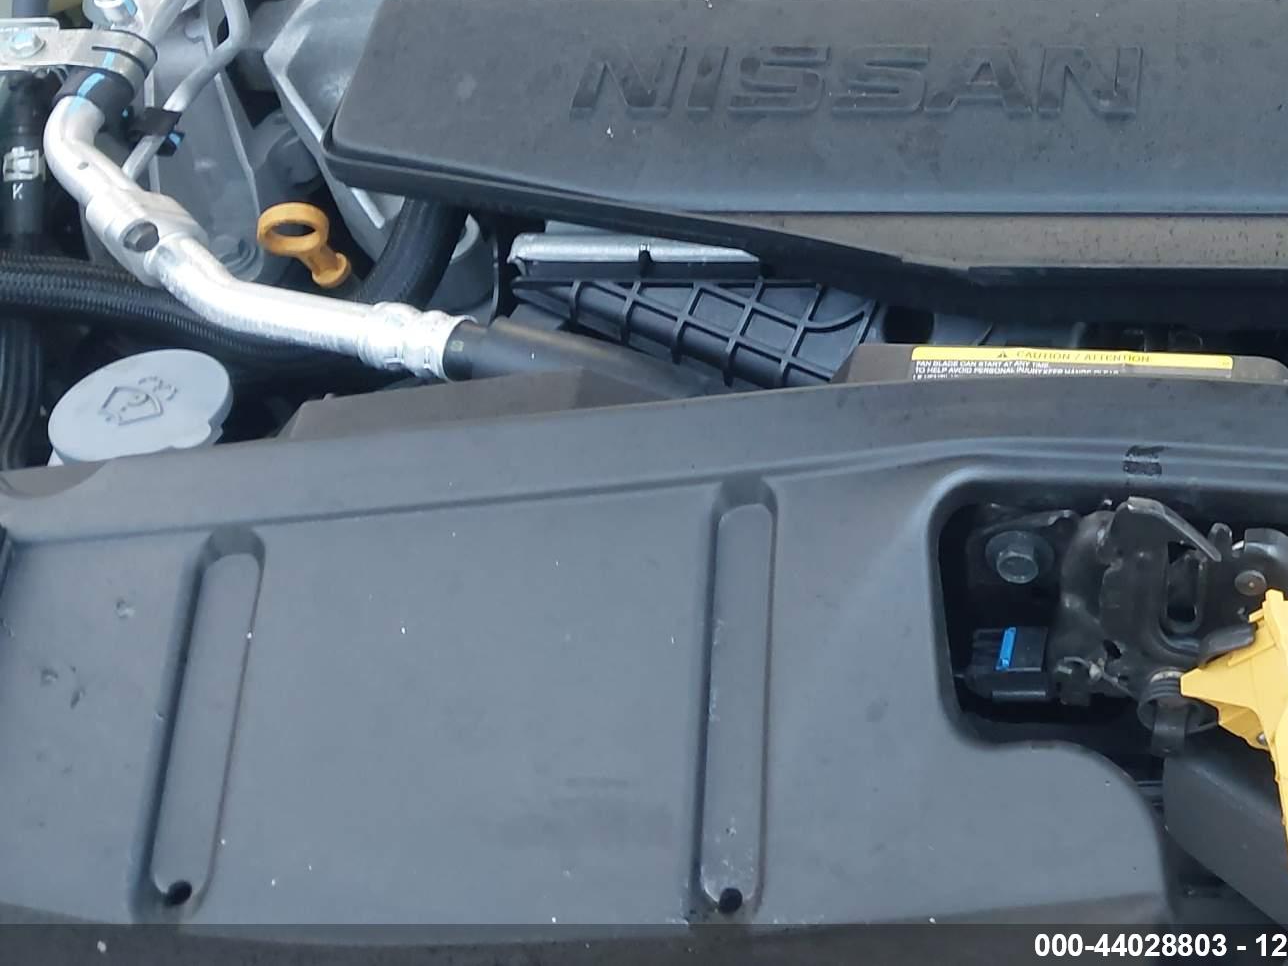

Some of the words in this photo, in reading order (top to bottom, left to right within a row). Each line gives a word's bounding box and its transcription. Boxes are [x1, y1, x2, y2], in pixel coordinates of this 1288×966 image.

[569, 45, 1144, 119] NISSAN
[1016, 351, 1070, 360] CAUTION
[1084, 354, 1150, 363] ATTENTION
[1014, 360, 1031, 368] ANY
[915, 366, 926, 374] TO
[926, 366, 948, 374] HELP
[948, 366, 973, 374] AVOID
[973, 367, 1016, 375] PERSONAL
